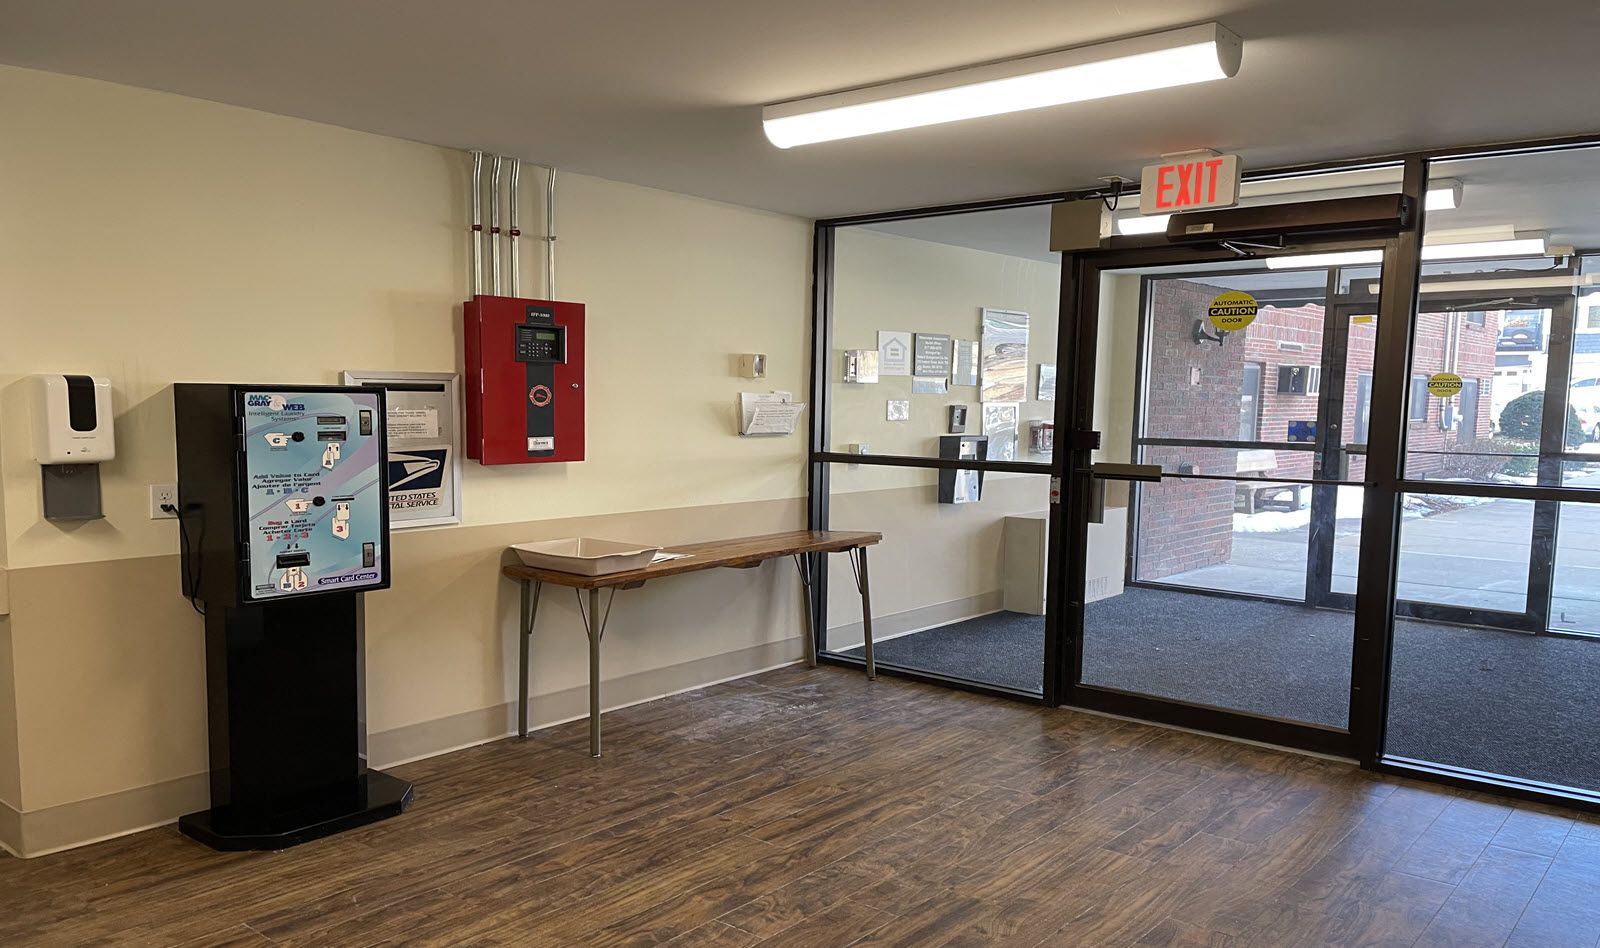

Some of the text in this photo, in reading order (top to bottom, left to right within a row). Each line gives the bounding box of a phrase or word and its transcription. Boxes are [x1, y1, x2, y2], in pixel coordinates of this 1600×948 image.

[1156, 159, 1223, 209] EXIT
[1210, 307, 1256, 316] CAUTION
[390, 492, 436, 502] TED STATES
[406, 500, 438, 508] SERVICE
[320, 577, 339, 585] Smart
[340, 574, 355, 582] Card
